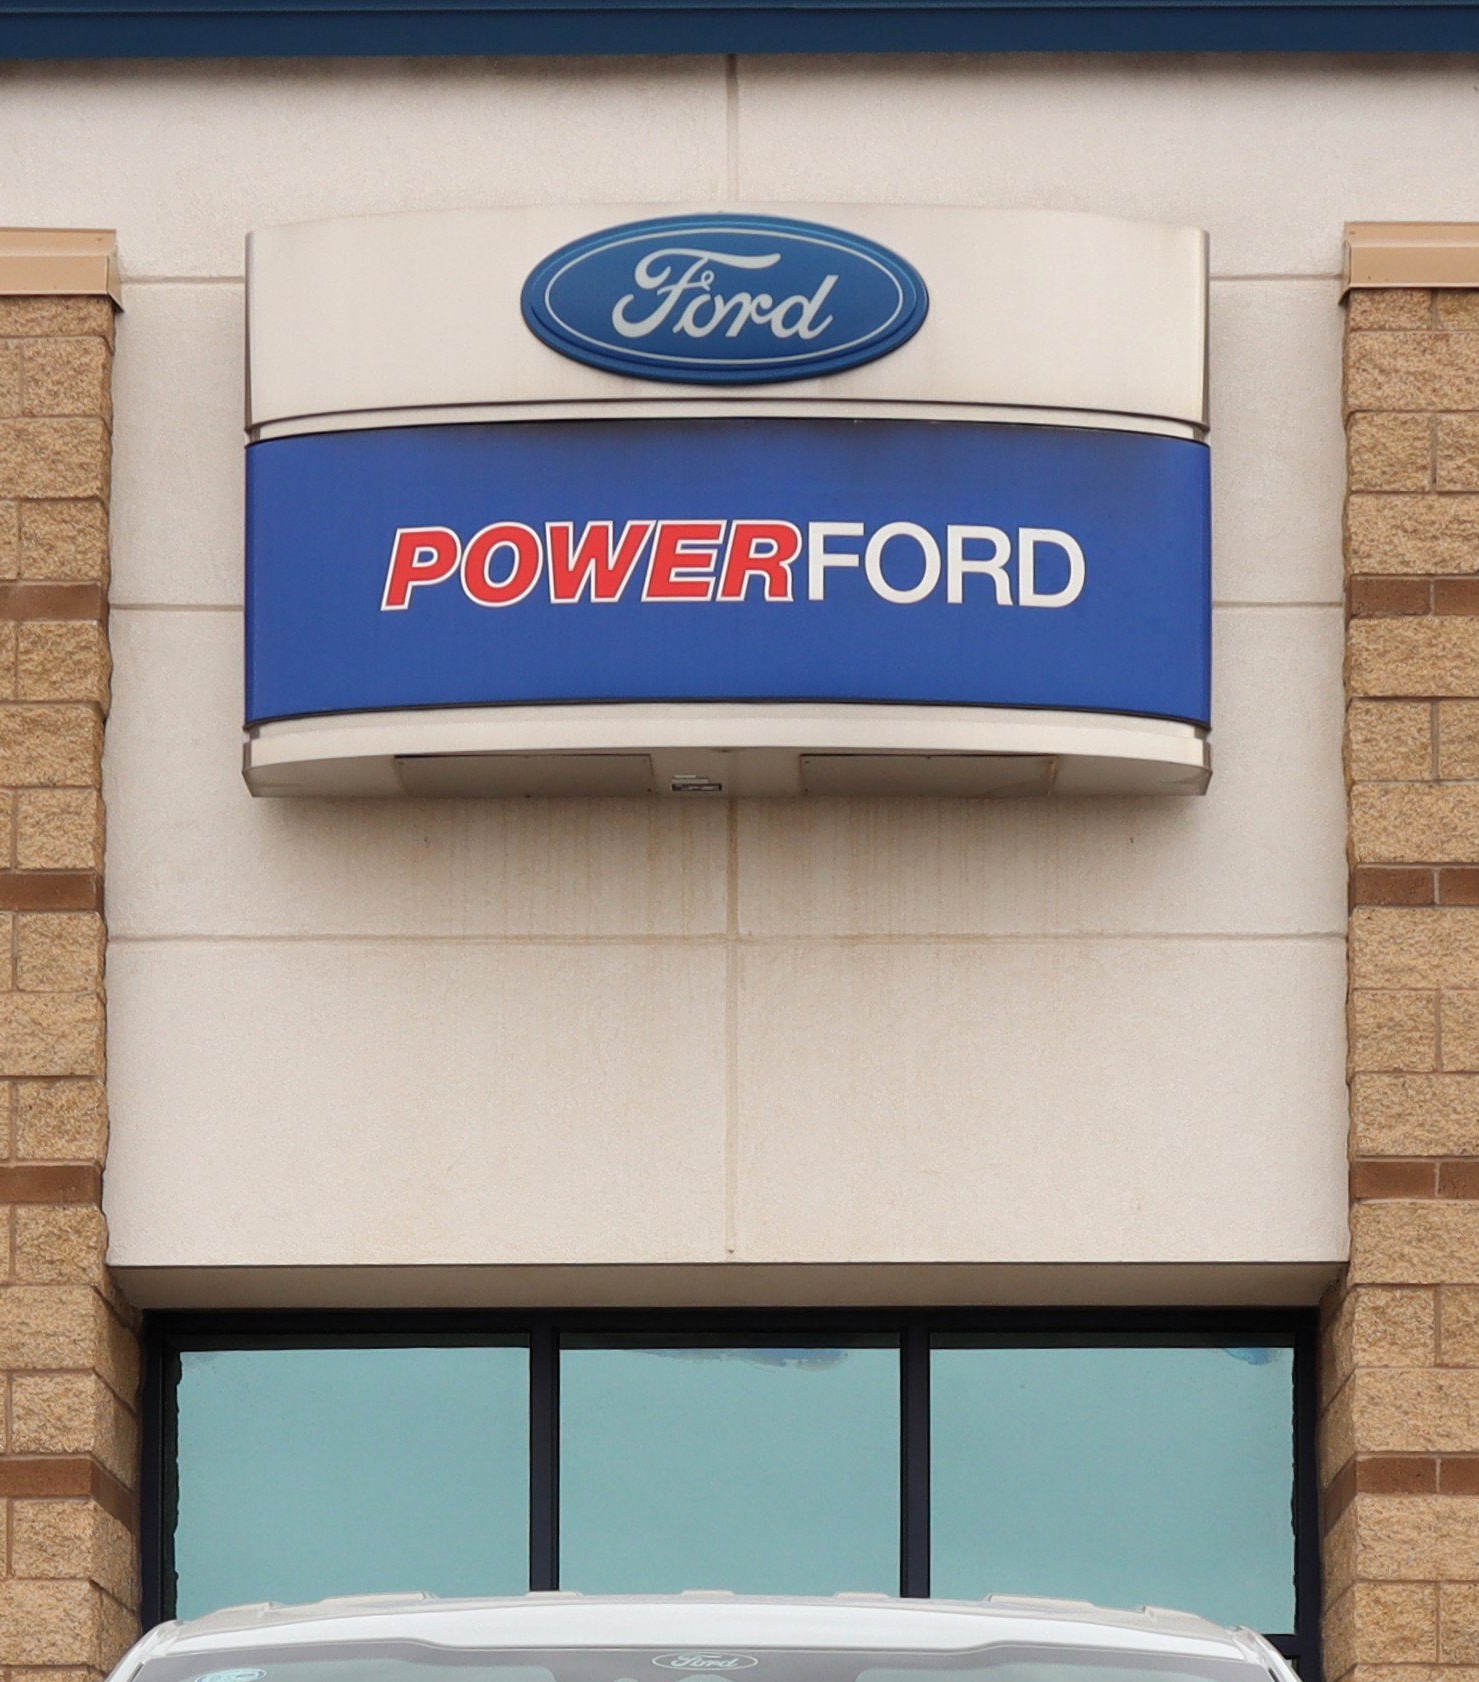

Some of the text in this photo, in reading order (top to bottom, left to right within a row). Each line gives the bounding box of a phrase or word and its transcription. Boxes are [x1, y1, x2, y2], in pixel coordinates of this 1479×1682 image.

[612, 248, 839, 339] Ford
[380, 519, 1086, 611] POWERFORD
[670, 1655, 739, 1667] Ford
